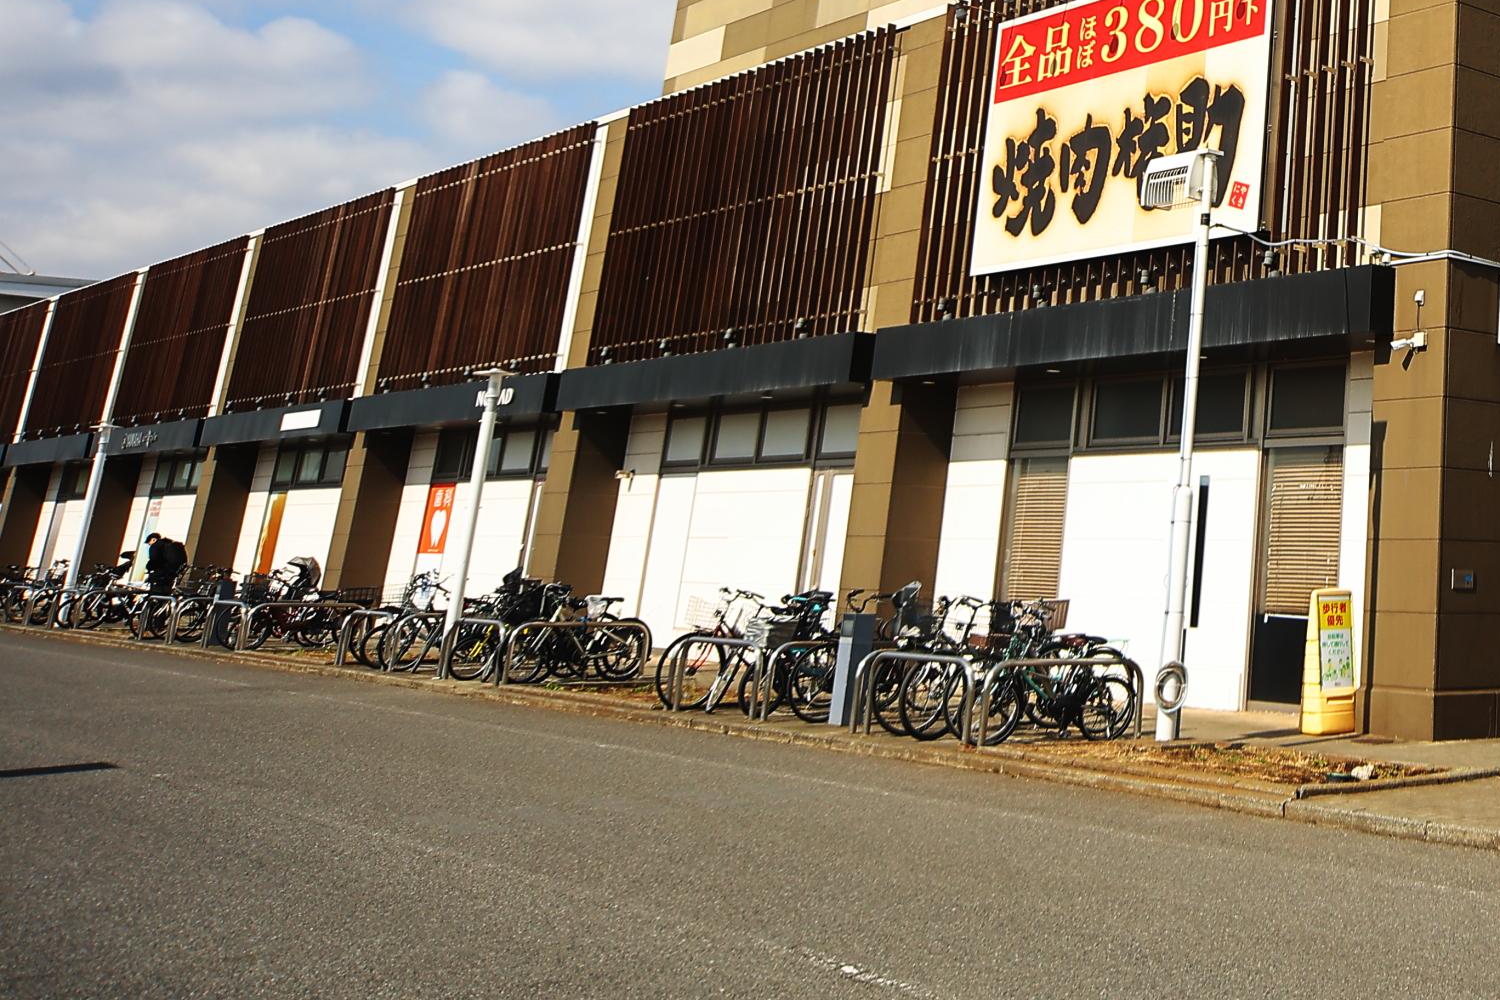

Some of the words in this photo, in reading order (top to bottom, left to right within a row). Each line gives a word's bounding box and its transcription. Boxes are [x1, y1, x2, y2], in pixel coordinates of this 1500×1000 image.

[475, 387, 514, 407] NAD
[1322, 602, 1347, 614] 歩行者
[1327, 615, 1343, 626] 優先
